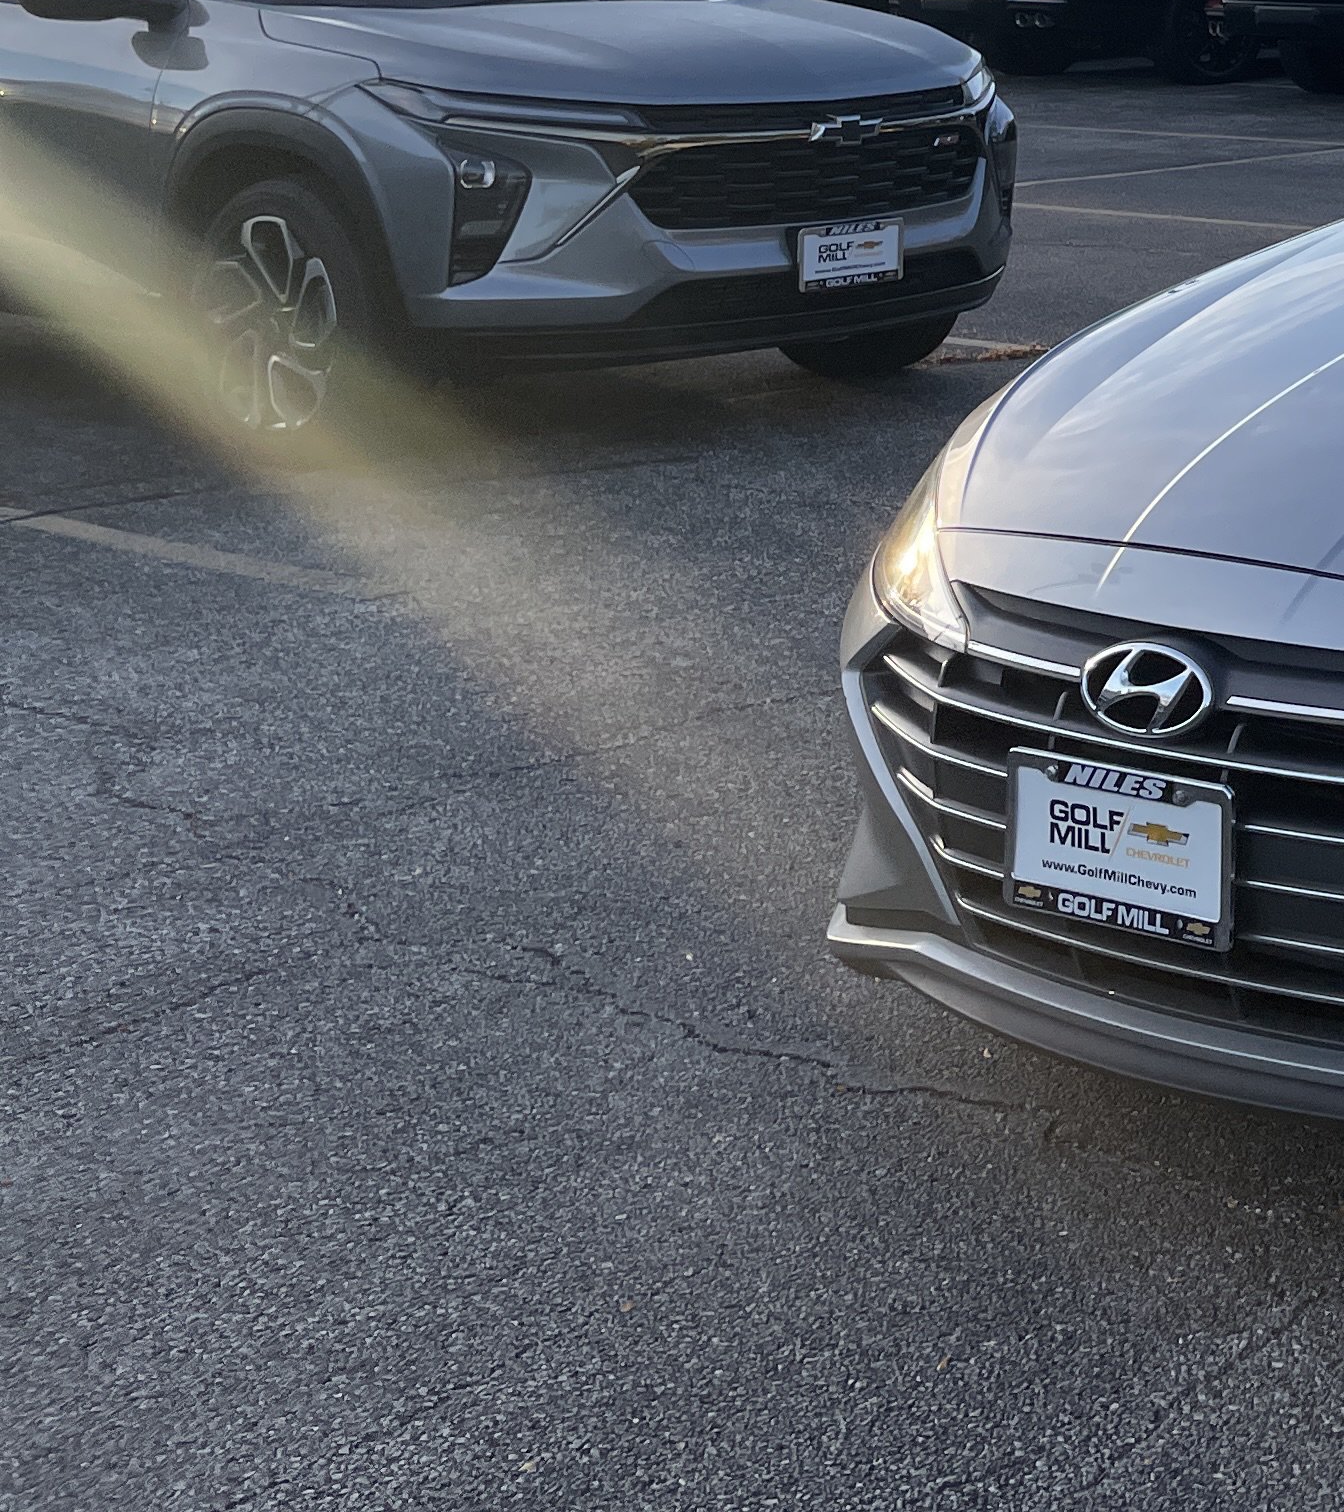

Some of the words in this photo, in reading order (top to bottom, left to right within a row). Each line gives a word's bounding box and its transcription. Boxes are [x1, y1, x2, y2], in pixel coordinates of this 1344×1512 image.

[829, 221, 877, 236] NILES
[818, 241, 854, 254] GOLF
[818, 252, 847, 264] MILL
[825, 275, 853, 288] GOLF
[853, 272, 878, 285] MILL
[1064, 763, 1167, 800] NILES
[1049, 798, 1124, 831] GOLF
[1049, 821, 1111, 855] MILL
[1125, 847, 1190, 868] CHEVROLET
[1041, 858, 1197, 899] www.GolfMillChevy.com
[1057, 892, 1116, 921] GOLF
[1116, 904, 1170, 935] MILL
